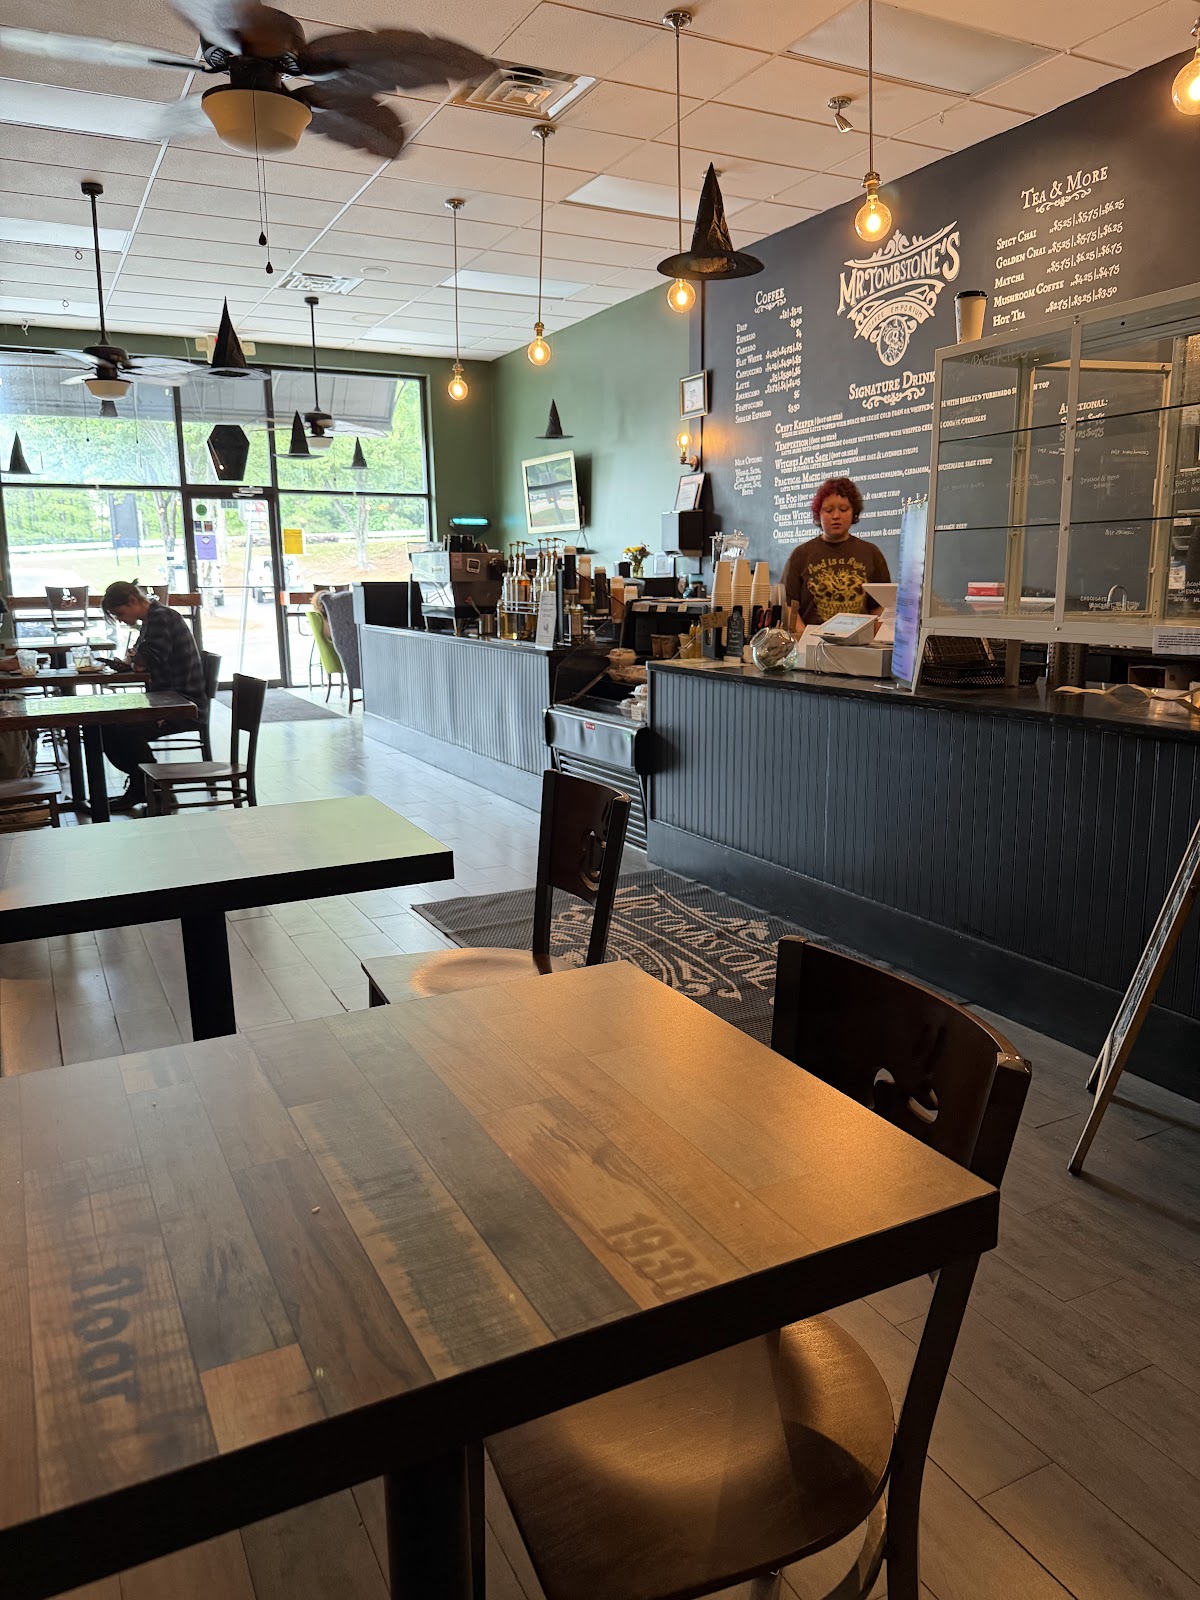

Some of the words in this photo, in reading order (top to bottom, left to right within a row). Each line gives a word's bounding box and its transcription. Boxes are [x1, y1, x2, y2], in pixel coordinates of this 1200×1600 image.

[1021, 187, 1046, 209] TEA
[1050, 181, 1062, 199] &
[1066, 166, 1108, 193] MORE
[1017, 230, 1037, 242] CHAI
[996, 252, 1026, 269] GOLDEN
[1026, 246, 1046, 258] CHAI
[837, 268, 868, 316] MR.
[865, 231, 960, 295] TOMBSTONE'S
[994, 273, 1025, 289] MATCHA
[755, 288, 785, 306] COFFEE
[993, 288, 1036, 308] MUSHROOM
[1036, 280, 1065, 294] COFFEE
[890, 304, 923, 318] EMPORIUM
[993, 315, 1010, 327] HOT
[1010, 309, 1026, 322] TEA
[736, 344, 756, 355] CORTADO
[736, 358, 747, 367] FLAT
[747, 354, 762, 364] WHITE
[736, 366, 762, 379] CAPPUCCINO
[736, 381, 750, 390] LATTE
[849, 379, 900, 400] SIGNATURE
[902, 370, 936, 388] DRINK
[735, 390, 760, 401] AMERICANO
[892, 408, 903, 416] FOAM
[910, 403, 930, 413] WHIPPED
[946, 397, 959, 406] WITH
[982, 387, 1011, 399] TURBINADO
[1038, 380, 1050, 389] TOP
[794, 420, 815, 430] KEEPER
[858, 434, 873, 442] BUTTER
[874, 431, 889, 439] TOPPED
[902, 425, 920, 434] WHIPPED
[774, 439, 808, 452] TEMPTATION
[882, 449, 902, 458] LAVENDER
[774, 458, 798, 470] WITCHES
[799, 455, 814, 465] LOVE
[815, 452, 828, 462] SAGE
[977, 457, 992, 465] SYRUP
[774, 476, 801, 487] PRACTICAL
[802, 472, 820, 482] MAGIC
[774, 494, 785, 505] THE
[786, 494, 797, 504] FOG
[773, 512, 791, 522] GREEN
[792, 510, 811, 520] WITCH
[877, 508, 897, 517] ROSEMARY
[773, 529, 794, 538] ORANGE
[794, 527, 819, 537] ALCHEMY
[634, 906, 776, 990] TOMBSTON
